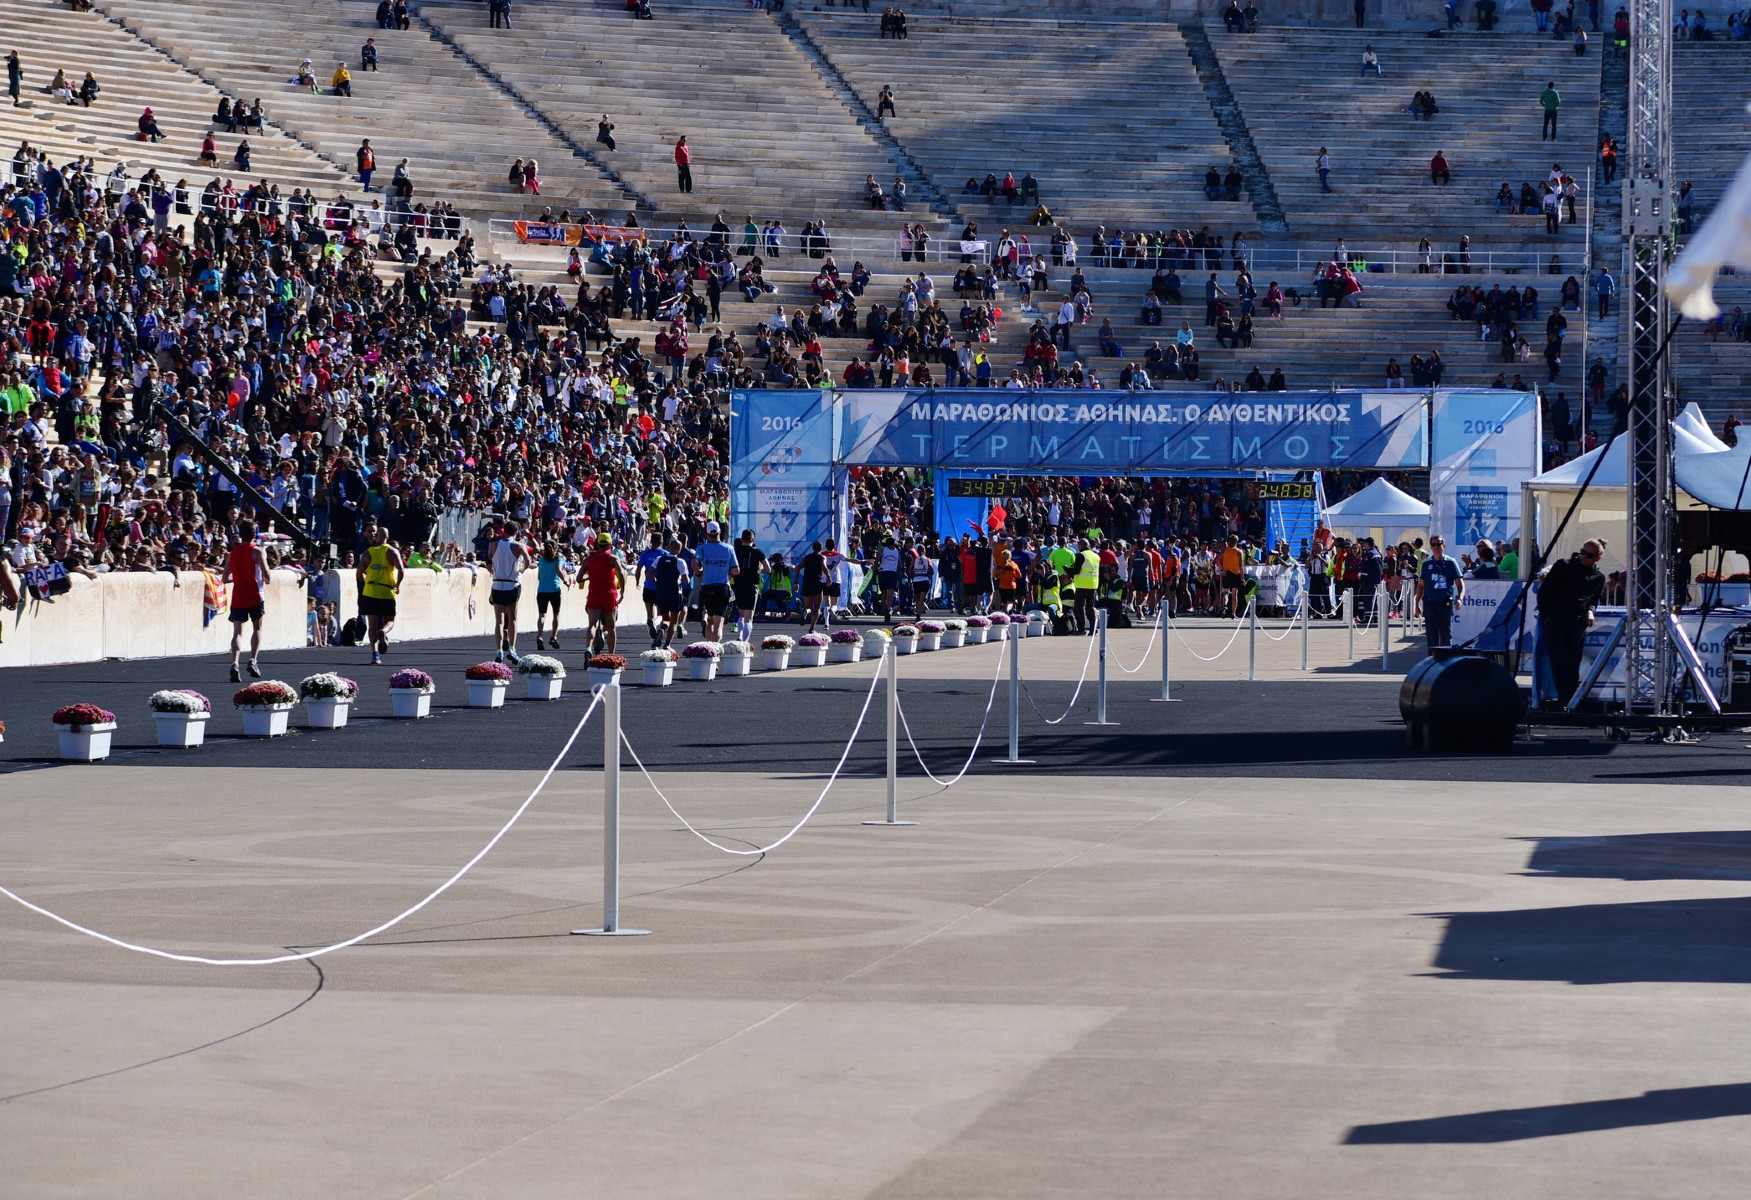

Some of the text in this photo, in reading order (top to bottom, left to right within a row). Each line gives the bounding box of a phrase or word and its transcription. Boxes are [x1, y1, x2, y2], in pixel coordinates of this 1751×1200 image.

[911, 403, 1350, 422] ΜΑΡΑΘΩΝΙΟΣ ΑΘΗΝΑΣ. Ο ΑΥΘΕΝΤΙΚΟΣ
[761, 416, 803, 431] 2016
[1463, 419, 1504, 434] 2016
[25, 564, 65, 585] RAFA
